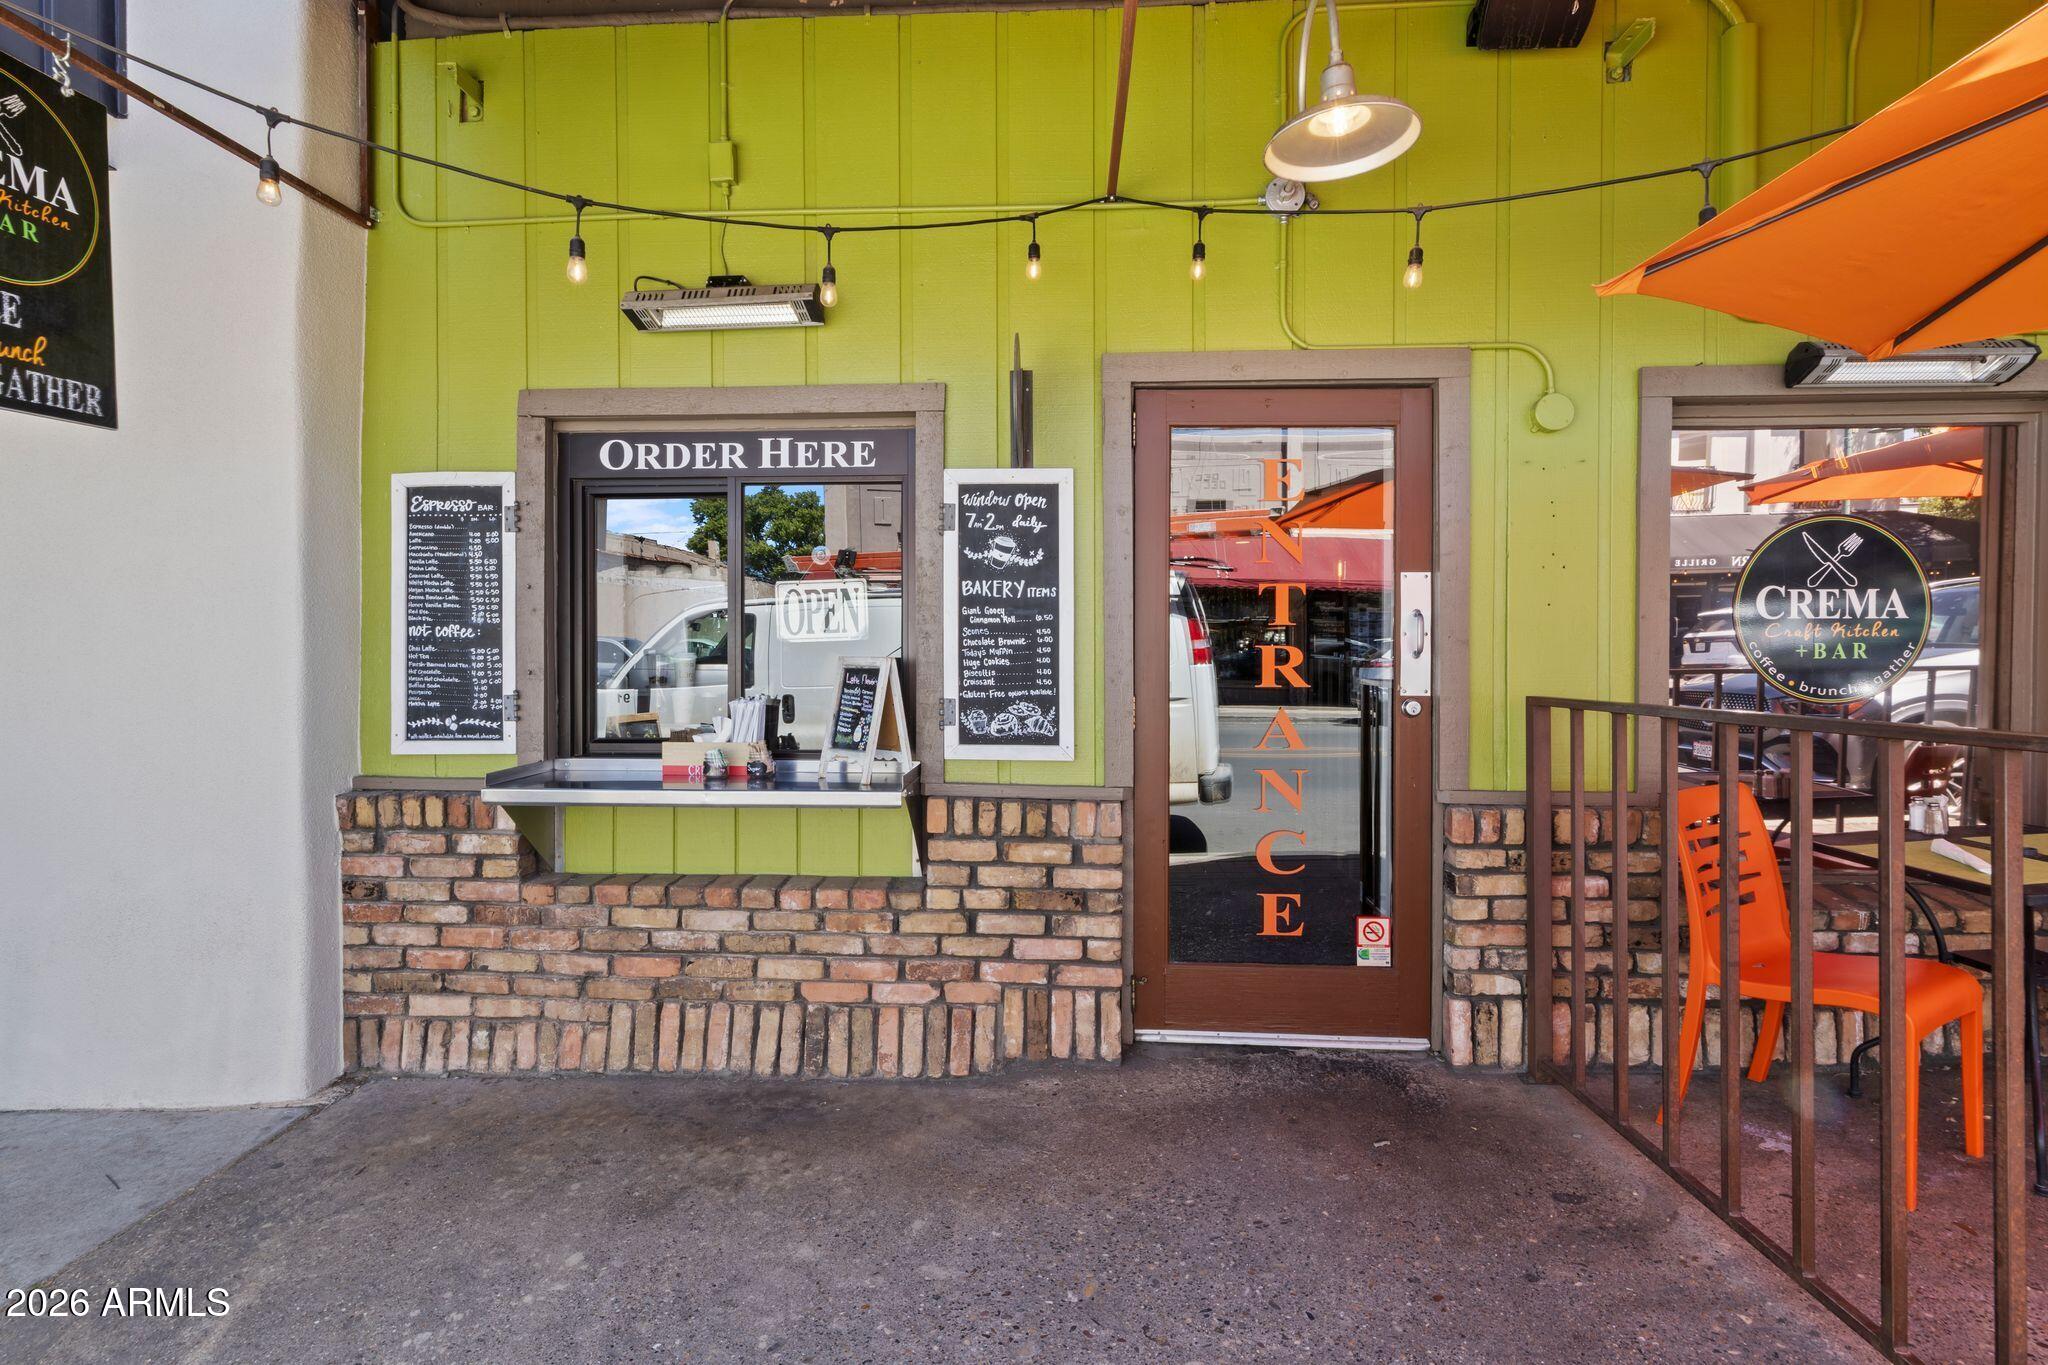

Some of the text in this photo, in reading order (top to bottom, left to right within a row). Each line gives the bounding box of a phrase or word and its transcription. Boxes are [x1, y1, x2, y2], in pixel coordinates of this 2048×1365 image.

[0, 363, 103, 417] ATHER
[600, 438, 876, 470] ORDER HERE
[410, 496, 476, 512] Espresso
[961, 490, 1047, 510] Window Open
[1012, 515, 1047, 533] daily
[962, 580, 1056, 598] BAKERY ITEMS
[1756, 585, 1909, 619] CREMA
[783, 588, 859, 635] OPEN
[962, 606, 1005, 617] Giant Gooey
[408, 624, 432, 637] not
[962, 627, 989, 636] Scones
[1765, 621, 1899, 640] Craft Kitchen
[963, 637, 995, 646] Chocolate
[998, 637, 1026, 646] Brownie
[962, 647, 986, 658] Today's
[990, 647, 1013, 656] Muffin
[963, 659, 980, 669] Huge
[984, 657, 1010, 666] Cookies
[1749, 641, 1917, 696] coffee brunch gather
[963, 678, 995, 686] Croissant
[1254, 458, 1311, 936] ENTRANCE
